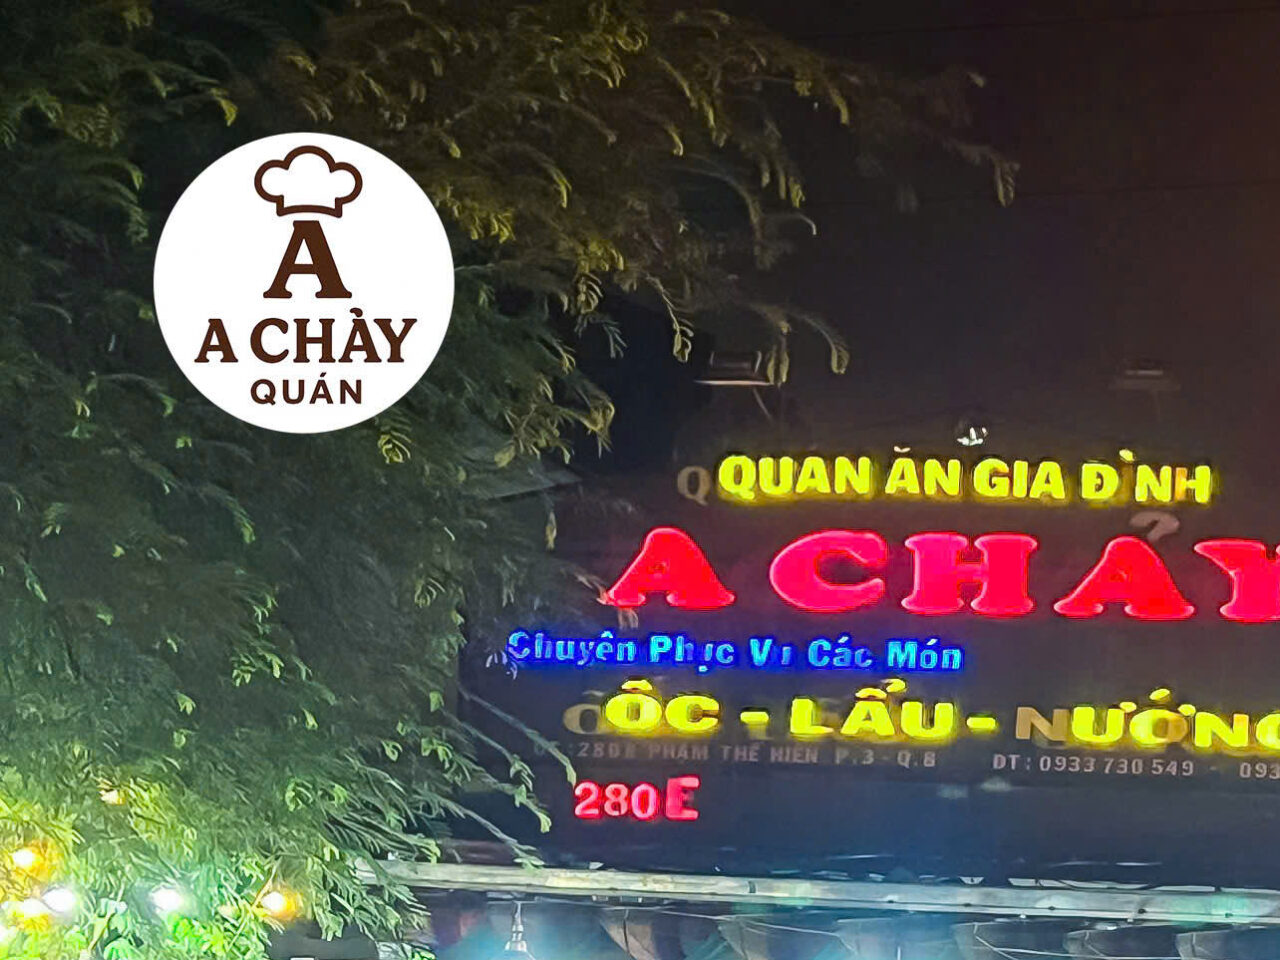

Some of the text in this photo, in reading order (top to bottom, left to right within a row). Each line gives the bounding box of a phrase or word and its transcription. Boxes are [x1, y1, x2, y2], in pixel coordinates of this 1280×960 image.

[885, 445, 960, 495] ĂN
[973, 457, 1065, 499] GIA
[606, 526, 736, 610] A
[807, 636, 873, 668] Các
[887, 638, 961, 670] Món
[1038, 755, 1096, 773] 0933
[1103, 757, 1143, 775] 730
[1151, 759, 1194, 777] 549
[573, 776, 700, 821] 280E
